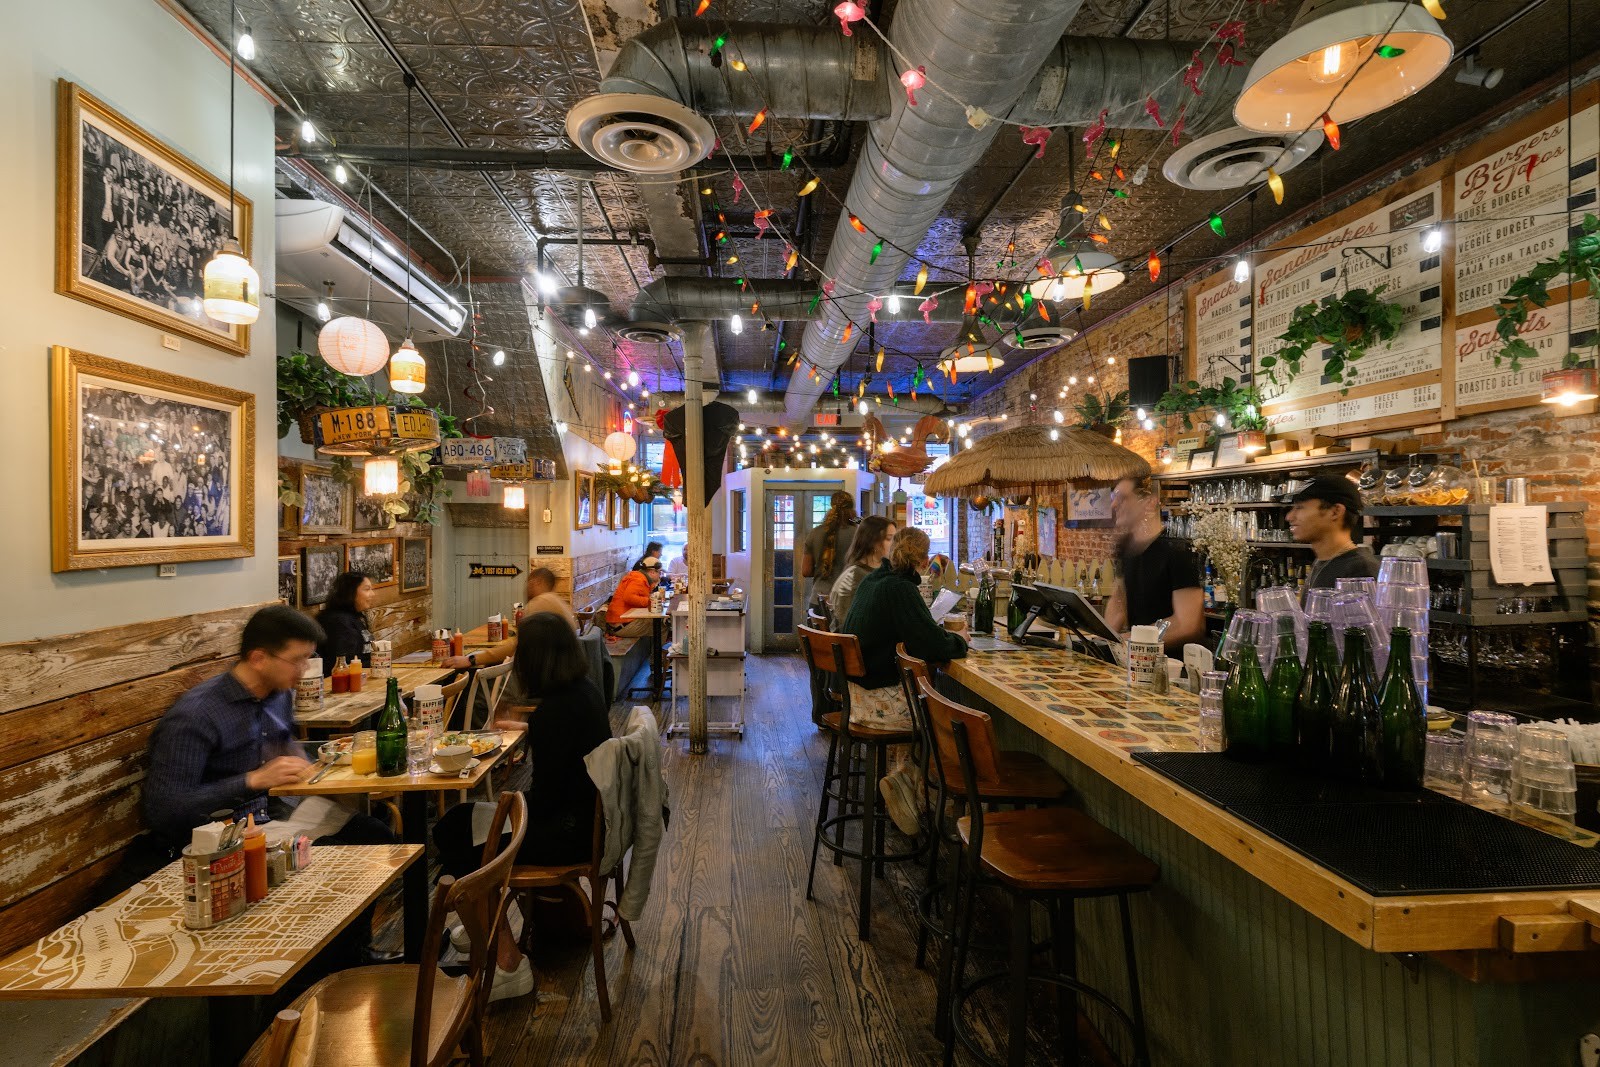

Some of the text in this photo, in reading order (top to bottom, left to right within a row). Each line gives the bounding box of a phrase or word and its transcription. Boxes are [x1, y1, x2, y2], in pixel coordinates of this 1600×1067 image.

[1460, 126, 1564, 200] Burgers
[1458, 203, 1486, 222] HOUSE
[1491, 185, 1531, 209] BURGER
[1458, 233, 1491, 253] VEGGIE
[1496, 216, 1535, 240] BURGER
[1260, 222, 1380, 289] Sandwiches
[1380, 243, 1409, 262] PESS
[1458, 262, 1484, 279] BAJA
[1489, 252, 1513, 269] FISH
[1519, 238, 1555, 258] TACOS
[1276, 286, 1290, 300] DOG
[1292, 279, 1310, 295] CLUB
[1458, 282, 1493, 303] SEARED
[1198, 281, 1241, 320] Snacks
[1211, 304, 1233, 319] NACHOS
[1413, 386, 1431, 396] CUTE
[1459, 377, 1497, 395] ROASTED
[1501, 372, 1525, 388] BEET
[1374, 393, 1399, 403] CHEESE
[1374, 401, 1393, 410] FRIES
[1413, 393, 1437, 403] SALAD
[331, 412, 376, 433] M-188
[1268, 414, 1296, 427] ides
